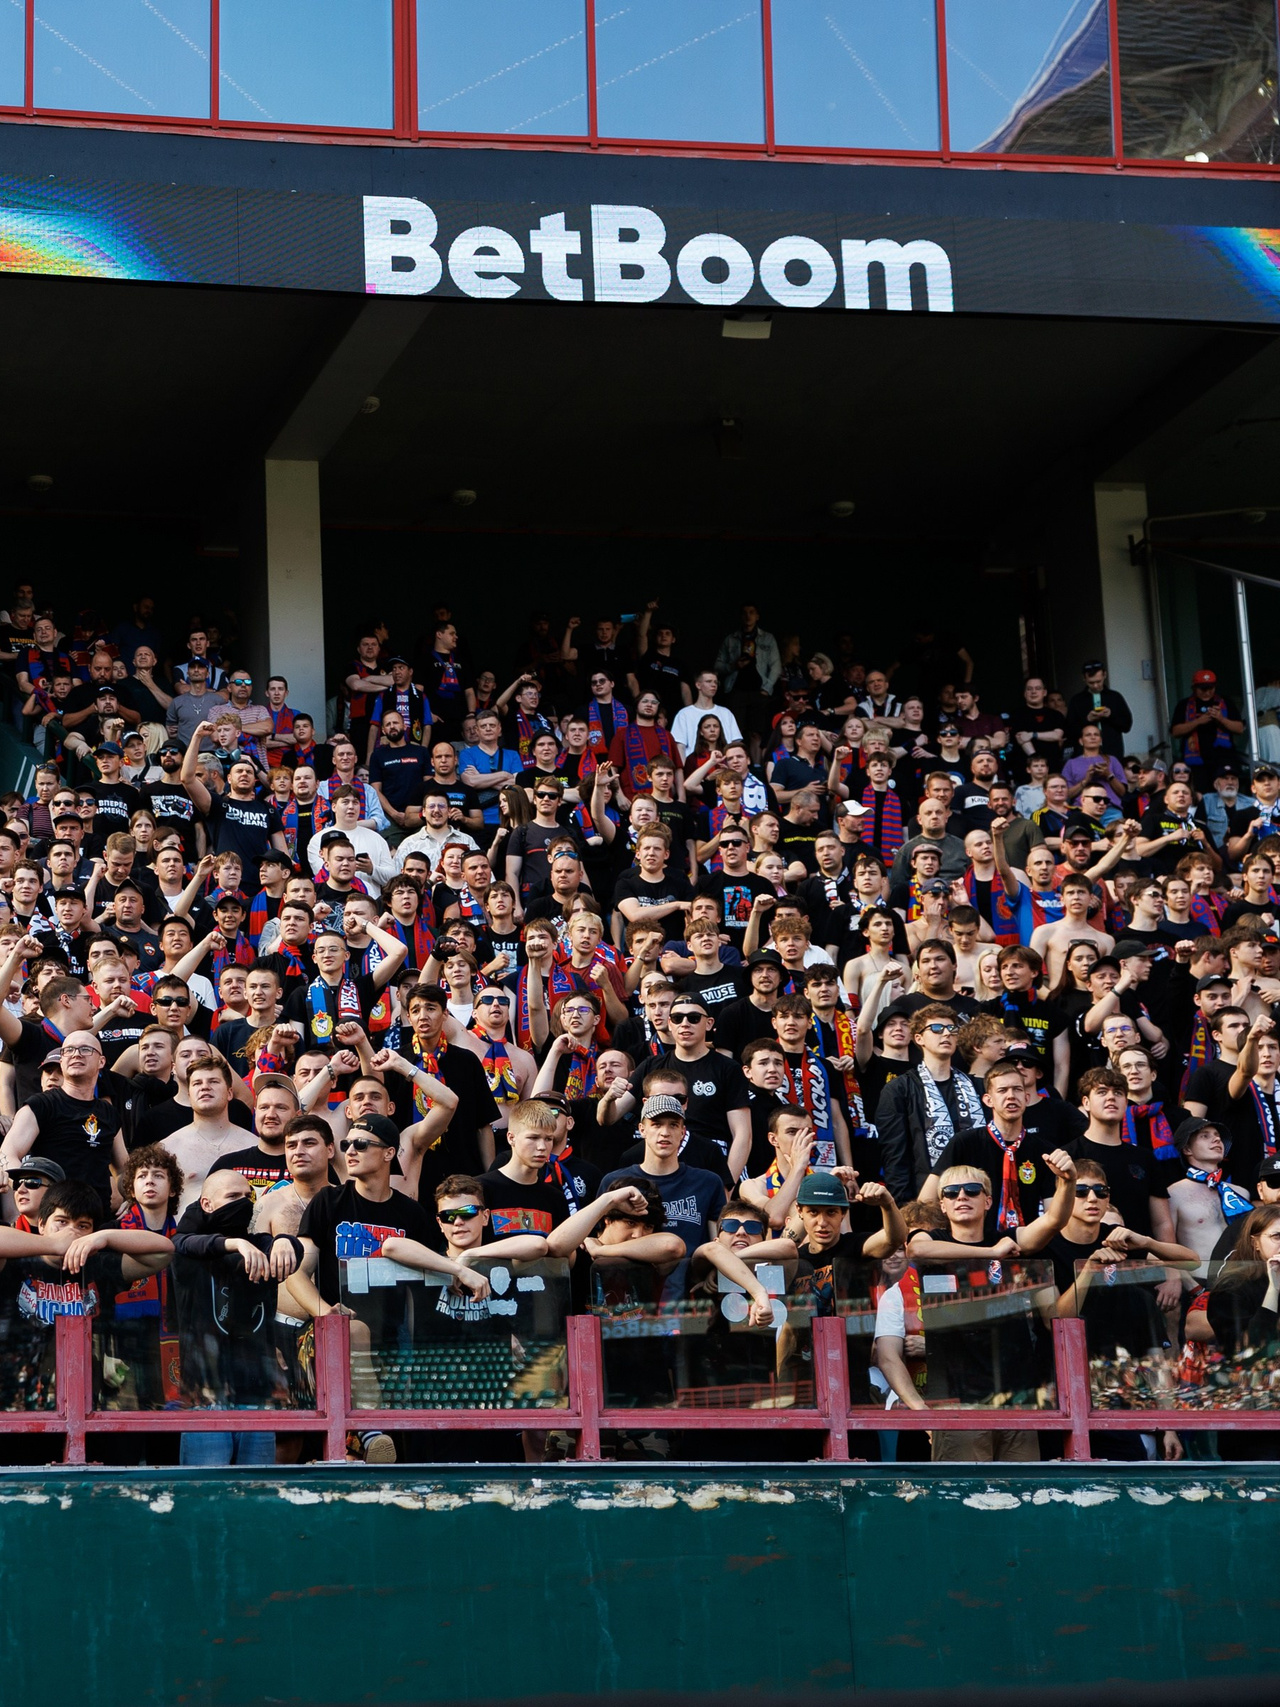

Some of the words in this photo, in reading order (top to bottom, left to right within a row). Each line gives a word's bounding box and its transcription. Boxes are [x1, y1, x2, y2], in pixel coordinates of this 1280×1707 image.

[363, 195, 954, 312] BetBoom
[227, 806, 268, 821] TOMMY
[240, 819, 268, 829] JEANS
[701, 985, 736, 1002] MUSE
[1021, 1017, 1049, 1030] NING
[807, 1062, 828, 1130] ЦСКА
[661, 1194, 698, 1218] DALE
[37, 1280, 83, 1304] СЛАВА
[36, 1302, 83, 1325] ЦСКА
[464, 1308, 492, 1321] MOSC
